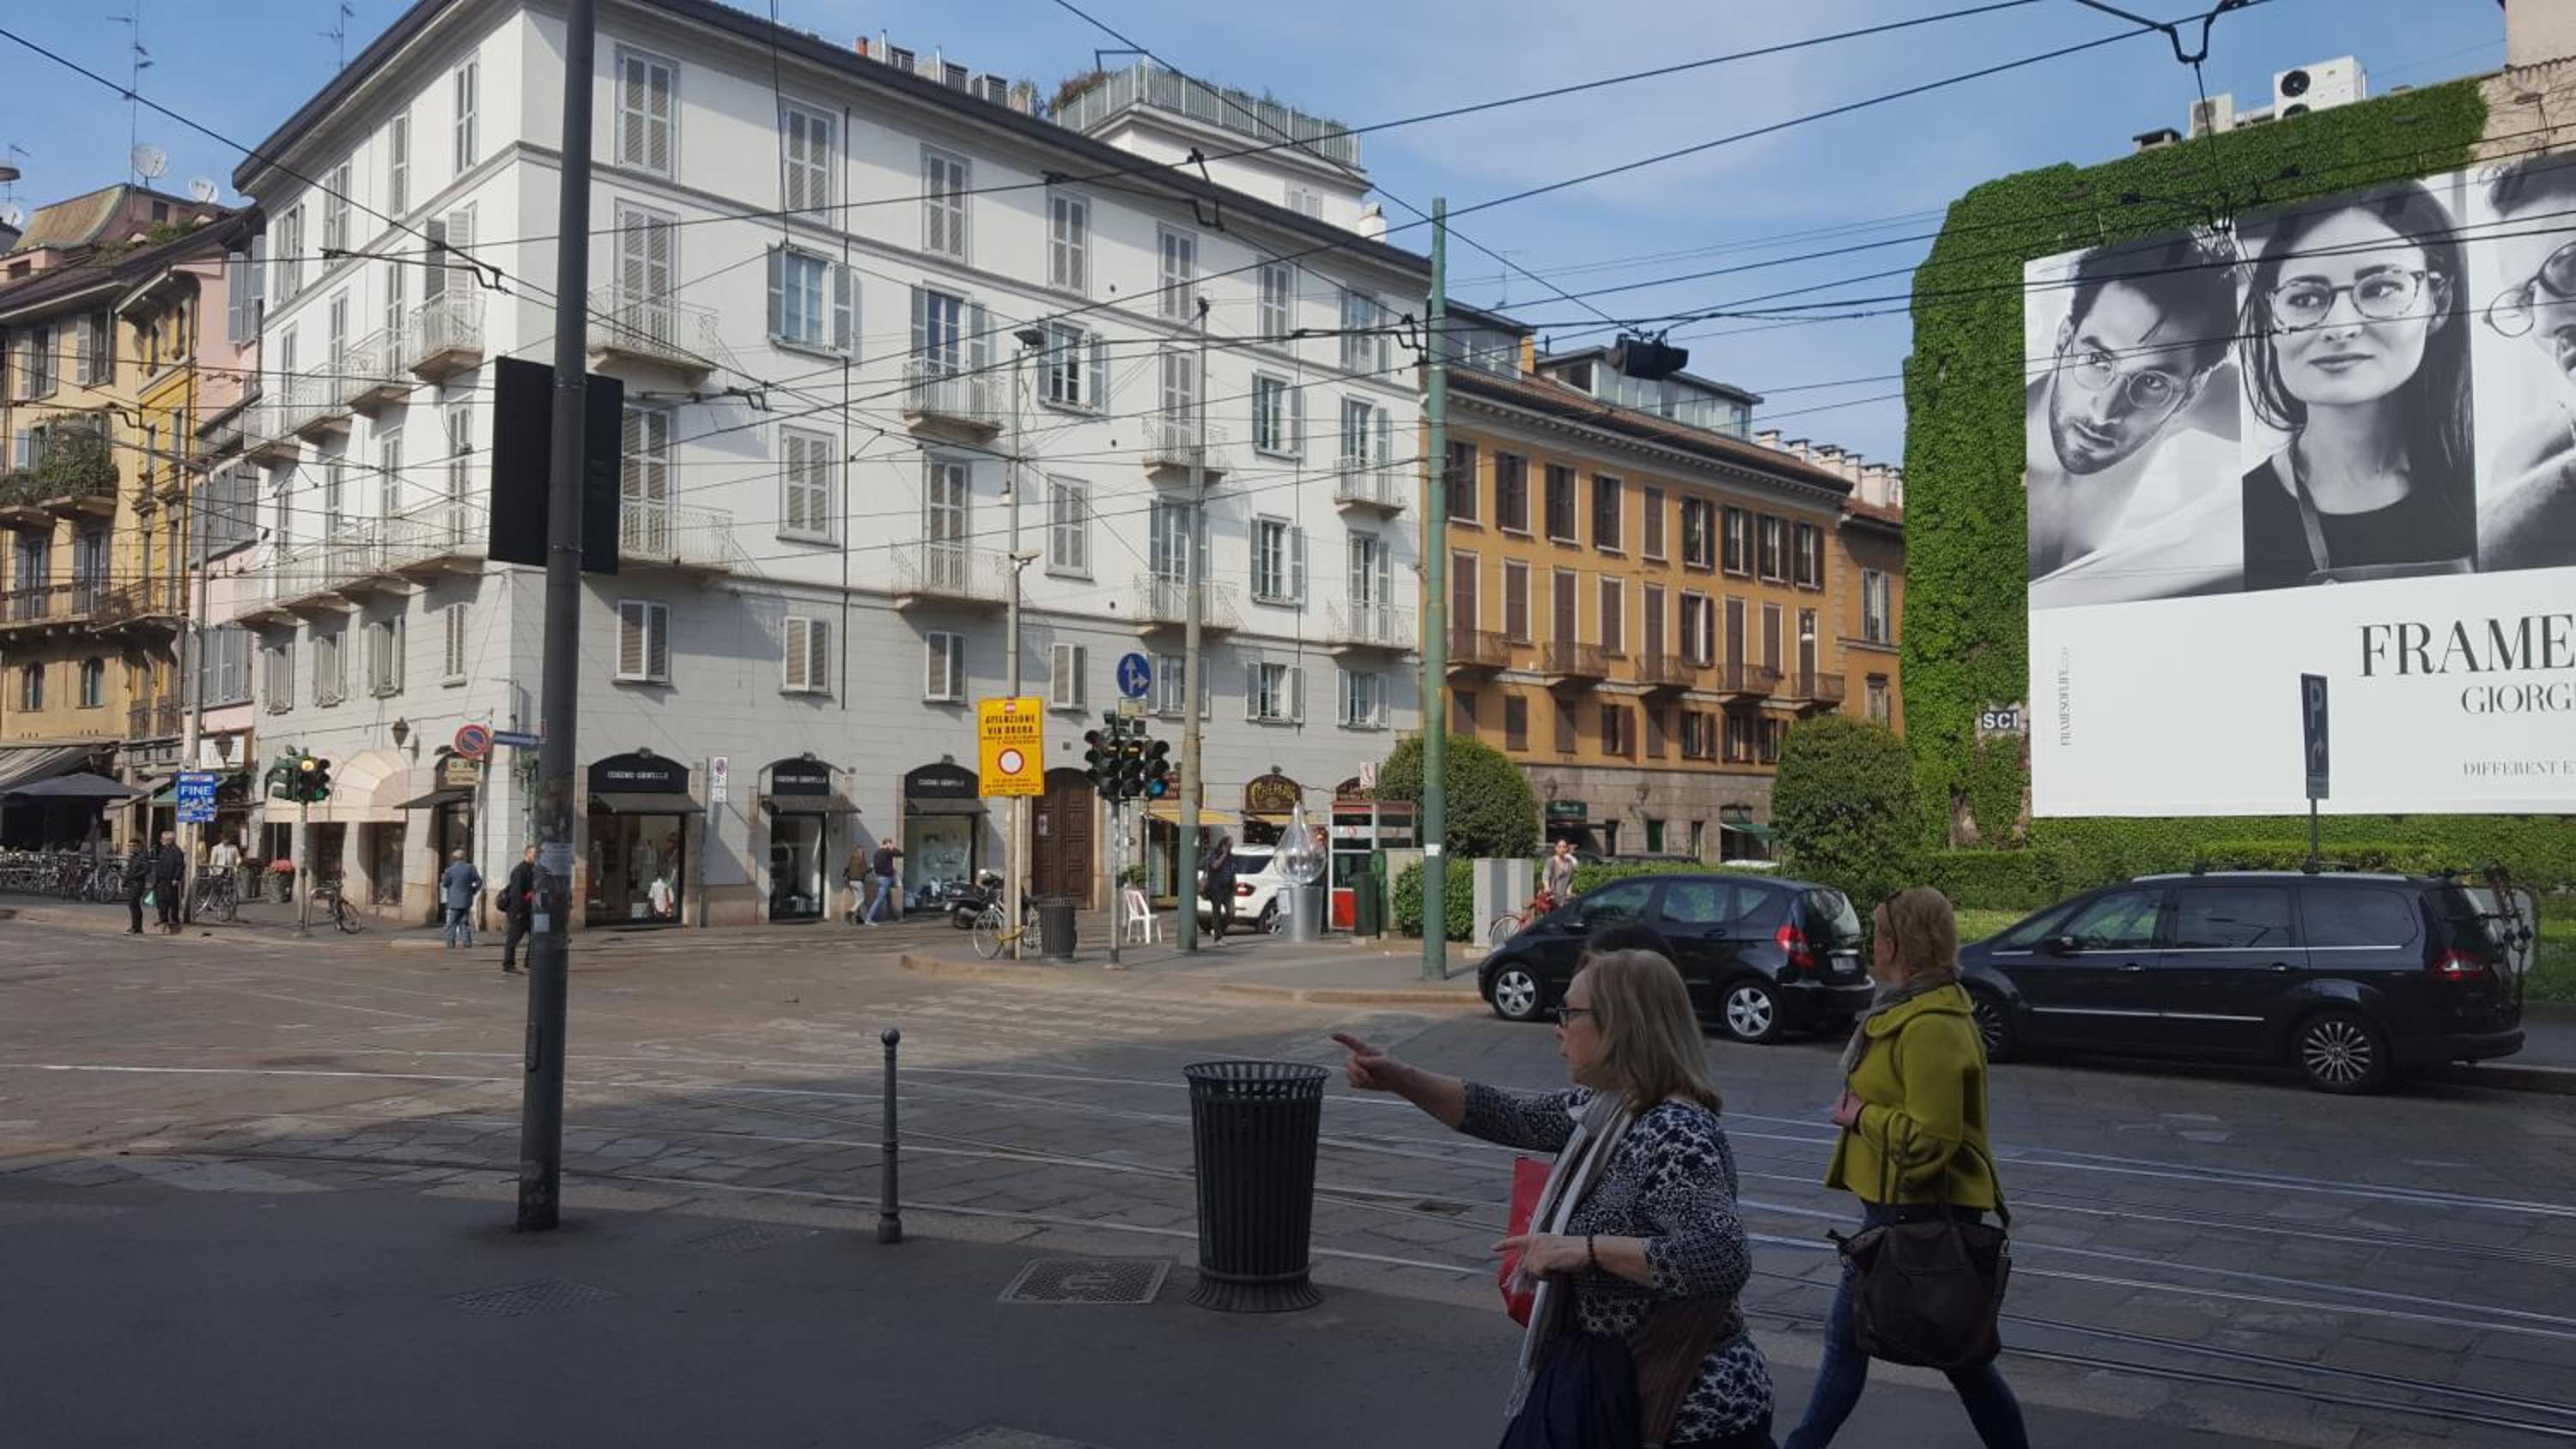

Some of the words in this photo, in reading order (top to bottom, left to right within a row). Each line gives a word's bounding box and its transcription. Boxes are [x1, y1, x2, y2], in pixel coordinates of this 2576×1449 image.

[2358, 614, 2576, 677] FRAME
[2307, 679, 2324, 729] P
[2461, 682, 2576, 714] GIORG
[1983, 712, 2018, 729] SCI
[2463, 761, 2556, 775] DIFFERENT
[181, 785, 213, 796] FINE
